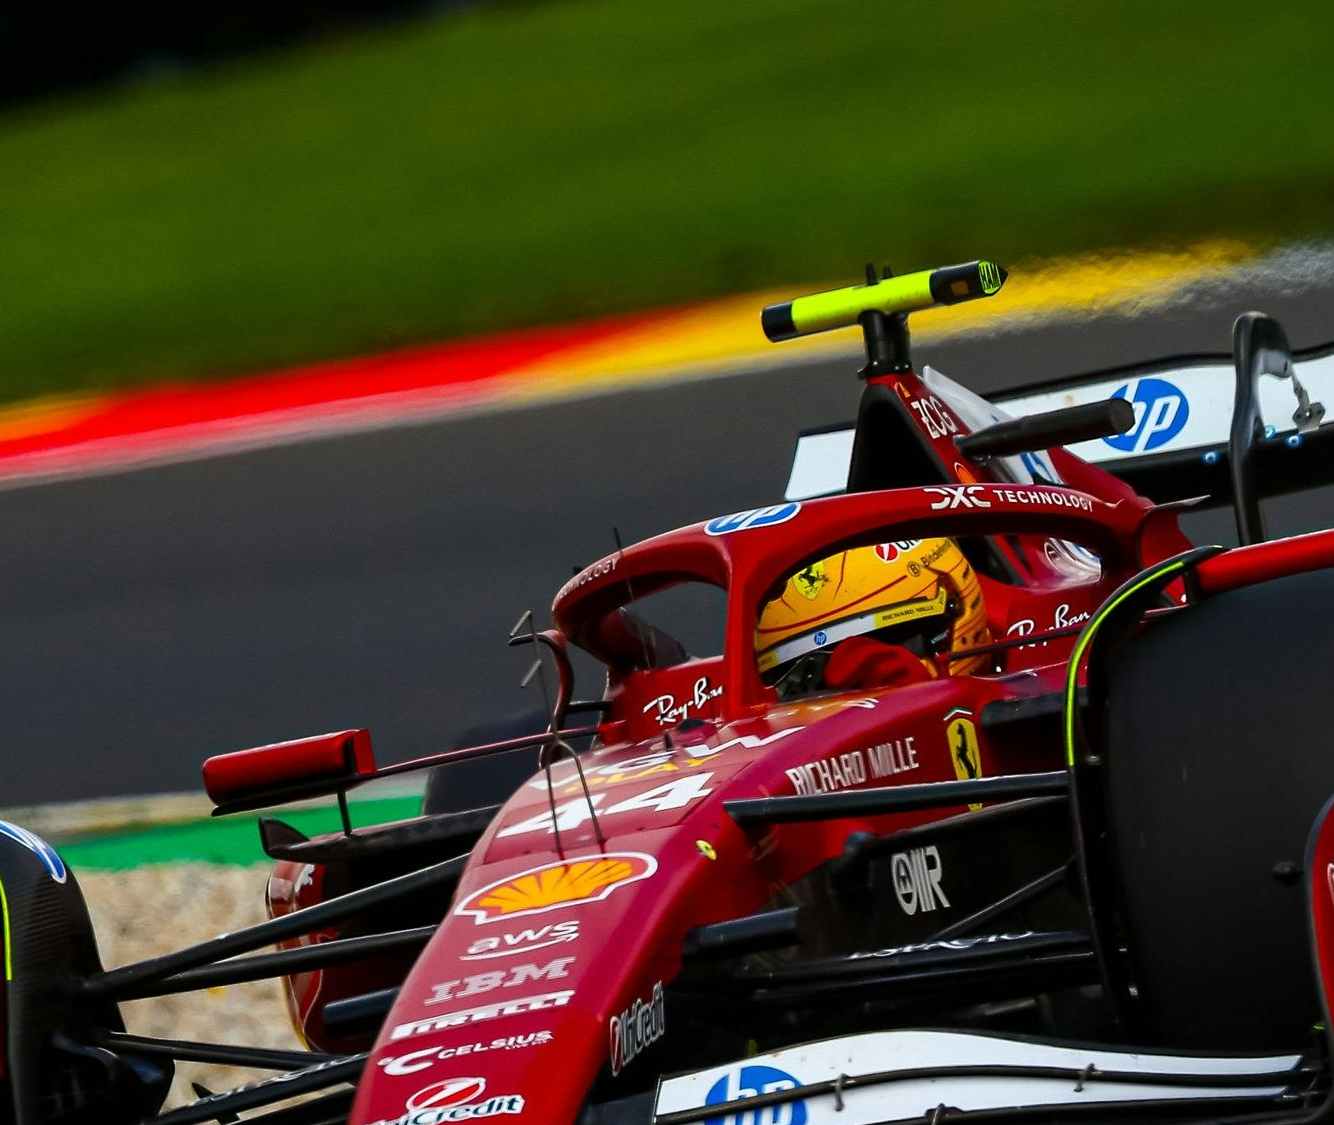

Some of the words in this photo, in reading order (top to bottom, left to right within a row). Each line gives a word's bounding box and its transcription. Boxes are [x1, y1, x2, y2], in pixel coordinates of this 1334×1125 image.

[978, 262, 1002, 293] HAM
[911, 395, 959, 439] ZCG
[924, 486, 992, 510] DXC
[993, 489, 1094, 513] TECHNOLOGY
[882, 608, 914, 621] RICHARD
[785, 750, 865, 795] RICHARD
[868, 736, 919, 779] MILLE
[497, 771, 715, 837] 44
[468, 920, 580, 956] aws
[424, 956, 576, 1006] IBM
[390, 990, 575, 1040] PIRELLI
[438, 1030, 554, 1060] CELSIUS
